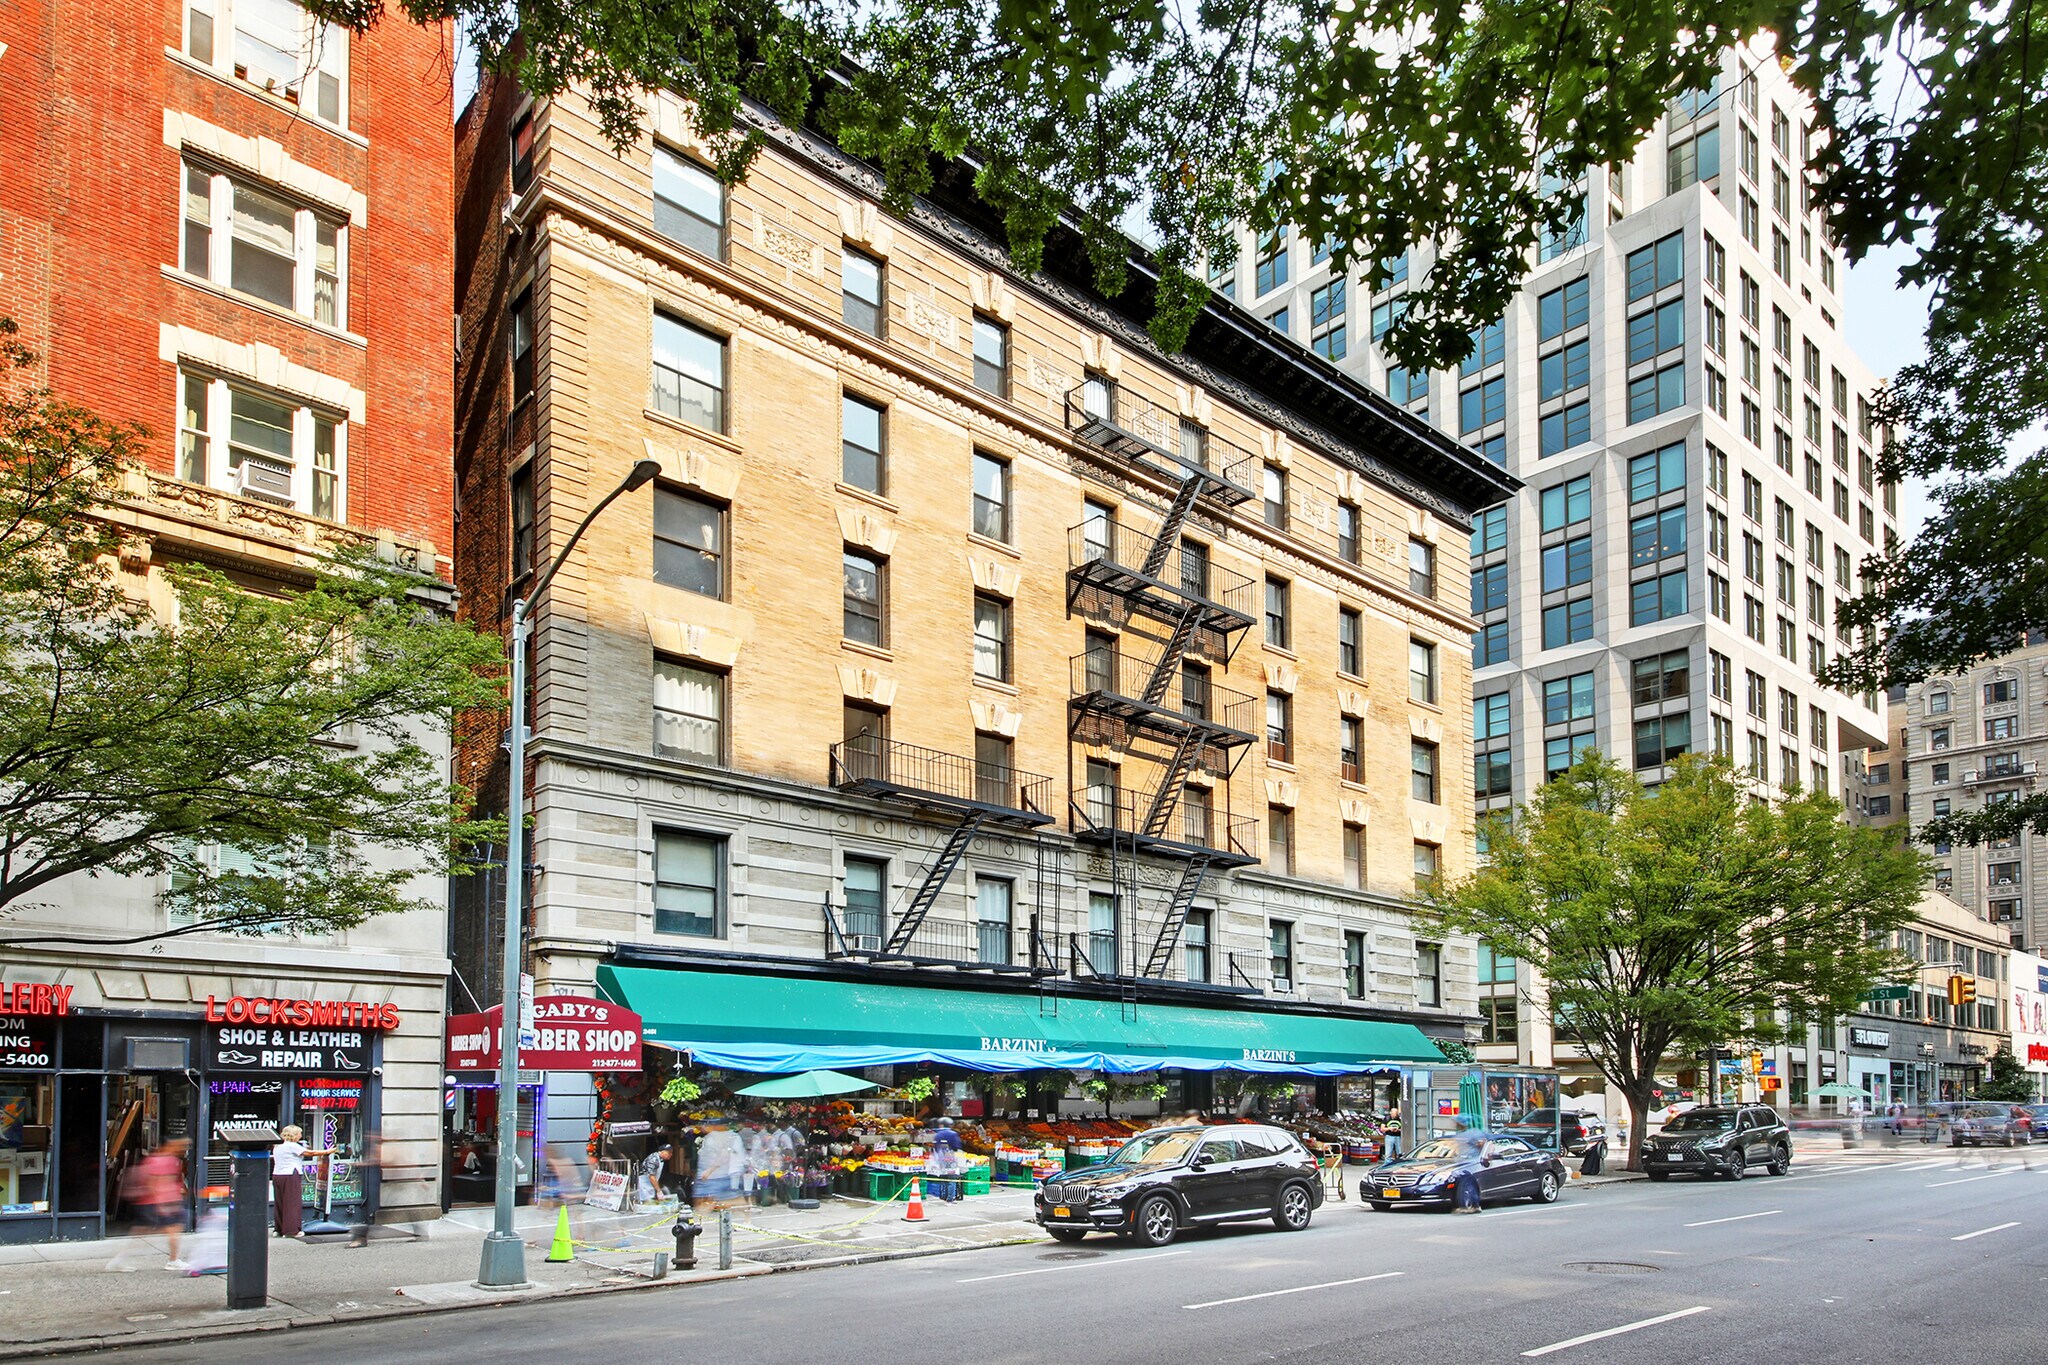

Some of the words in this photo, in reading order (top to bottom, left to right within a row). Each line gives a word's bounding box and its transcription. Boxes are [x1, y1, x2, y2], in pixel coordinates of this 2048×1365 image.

[1880, 989, 1890, 998] St
[206, 995, 400, 1030] LOCKSMITHS
[534, 1003, 609, 1021] GABY'S
[219, 1028, 266, 1045] SHOE
[271, 1030, 285, 1046] &
[289, 1031, 362, 1047] LEATHER
[451, 1033, 469, 1052] BARBER
[469, 1033, 483, 1051] SHOP
[498, 1028, 581, 1052] RBER
[585, 1029, 637, 1052] SHOP
[1860, 1029, 1889, 1046] FLOWERY
[261, 1051, 322, 1068] REPAIR
[1243, 1049, 1296, 1062] BARZINI'S
[592, 1059, 637, 1067] 212-877-1600
[299, 1079, 362, 1089] LOCKSMITHS
[301, 1088, 310, 1097] 24
[311, 1088, 331, 1097] HOUR
[331, 1089, 361, 1098] SERVICE
[303, 1097, 358, 1109] 212-877-7787
[1491, 1110, 1512, 1123] Family
[213, 1120, 278, 1130] MANHATTAN
[595, 1173, 612, 1185] BARBER
[611, 1176, 624, 1187] SHOP
